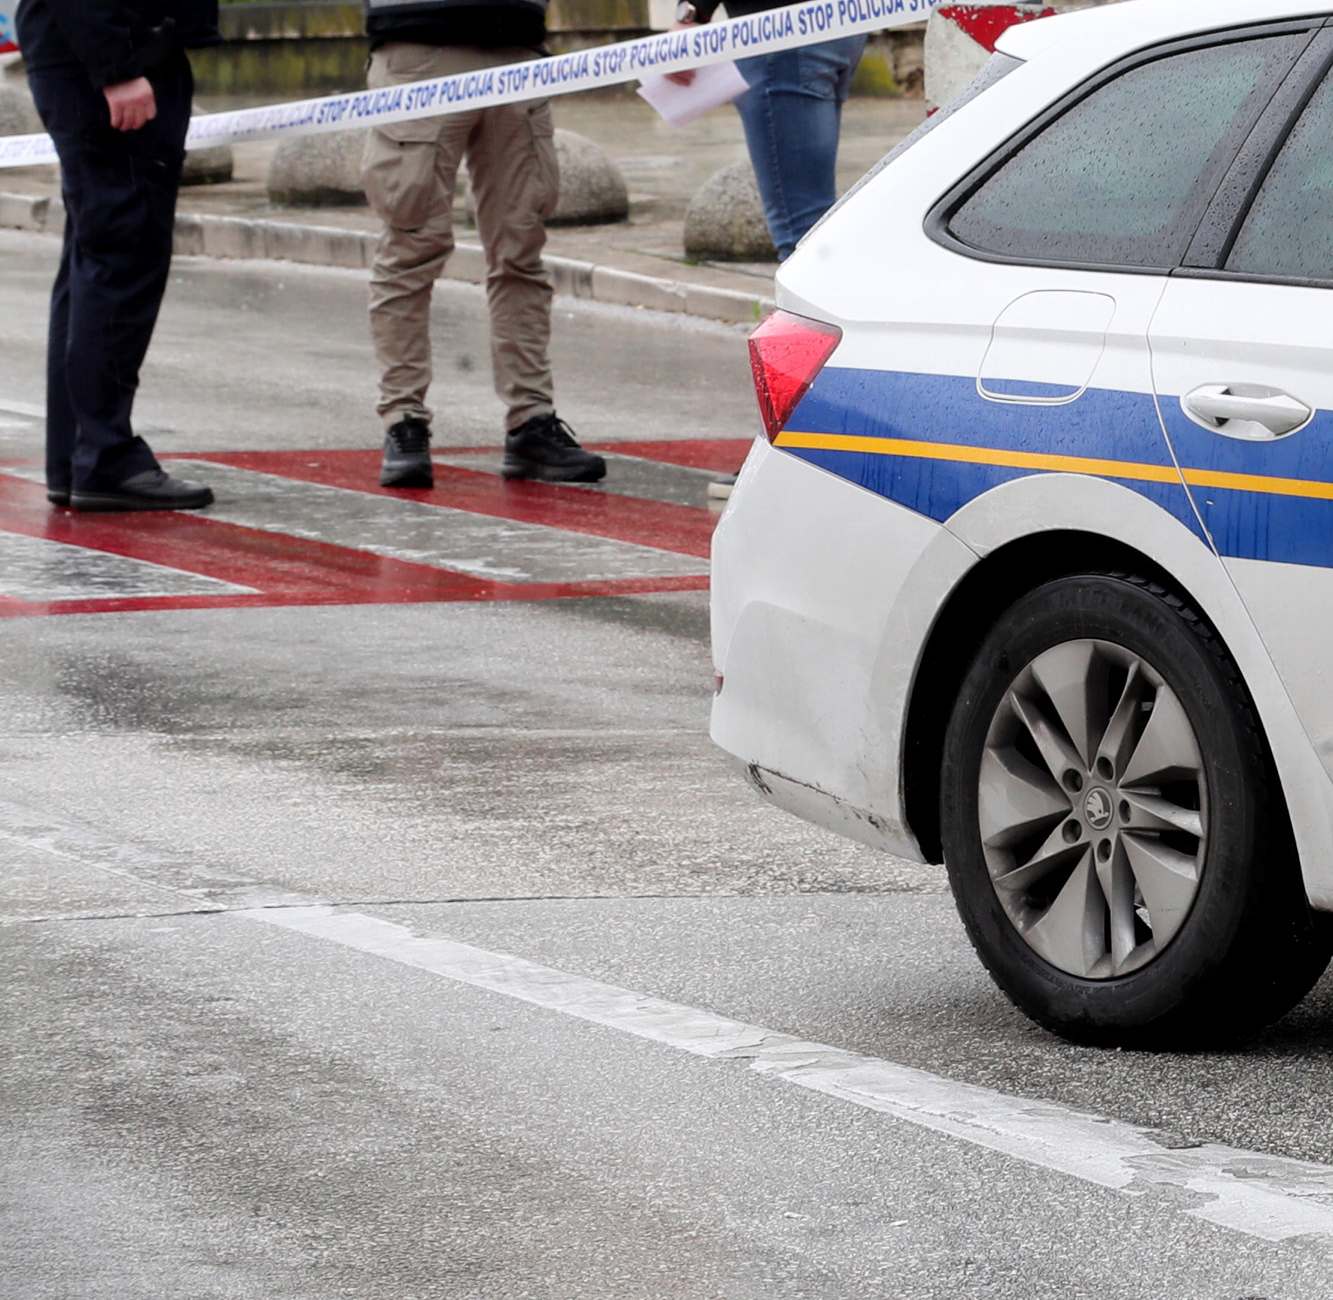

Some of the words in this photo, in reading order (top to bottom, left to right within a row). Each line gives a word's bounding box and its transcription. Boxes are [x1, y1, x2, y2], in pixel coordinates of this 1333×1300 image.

[316, 100, 349, 124] STOP
[350, 88, 401, 118] POLICIJA
[405, 84, 438, 111] STOP
[438, 75, 494, 105] POLICIJA
[498, 66, 530, 95] STOP
[533, 54, 589, 87] POLICIJA
[593, 49, 626, 77] STOP
[629, 33, 688, 69] POLICIJA
[693, 26, 727, 57] STOP
[732, 11, 794, 48] POLICIJA
[798, 3, 834, 35] STOP
